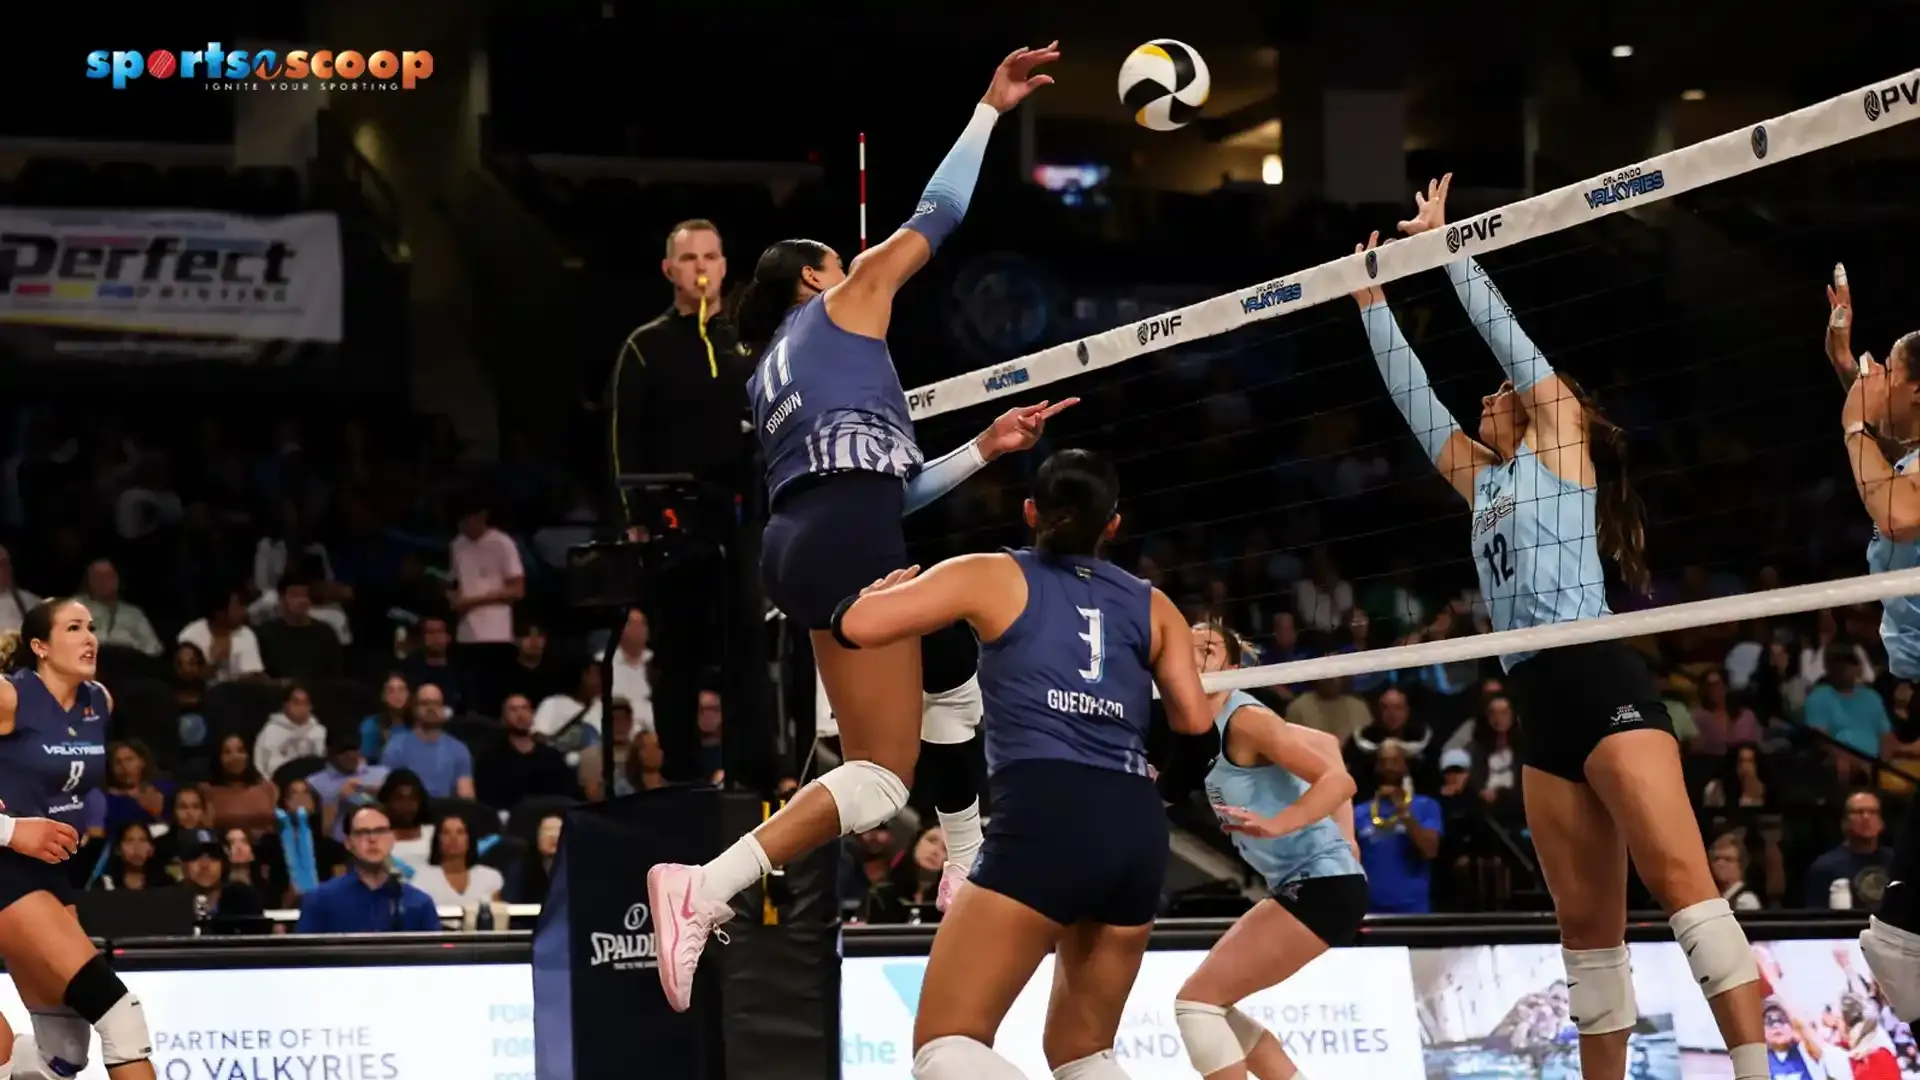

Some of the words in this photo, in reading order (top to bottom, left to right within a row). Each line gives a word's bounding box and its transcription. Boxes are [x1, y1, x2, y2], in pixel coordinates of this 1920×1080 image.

[1584, 170, 1665, 209] VALKYRIES
[1603, 167, 1641, 186] ORLANDO
[1460, 214, 1502, 246] PVF
[0, 232, 296, 292] Perfect
[1150, 315, 1182, 341] PVF
[763, 336, 792, 404] 11
[1483, 533, 1514, 588] 12
[1076, 605, 1105, 684] 3
[62, 760, 85, 792] 8
[591, 932, 657, 966] SPALDI
[1321, 1003, 1362, 1022] THE
[155, 1030, 272, 1051] PARTNER
[280, 1028, 313, 1049] OF
[321, 1027, 372, 1047] THE
[203, 1053, 399, 1080] VALKYRIES
